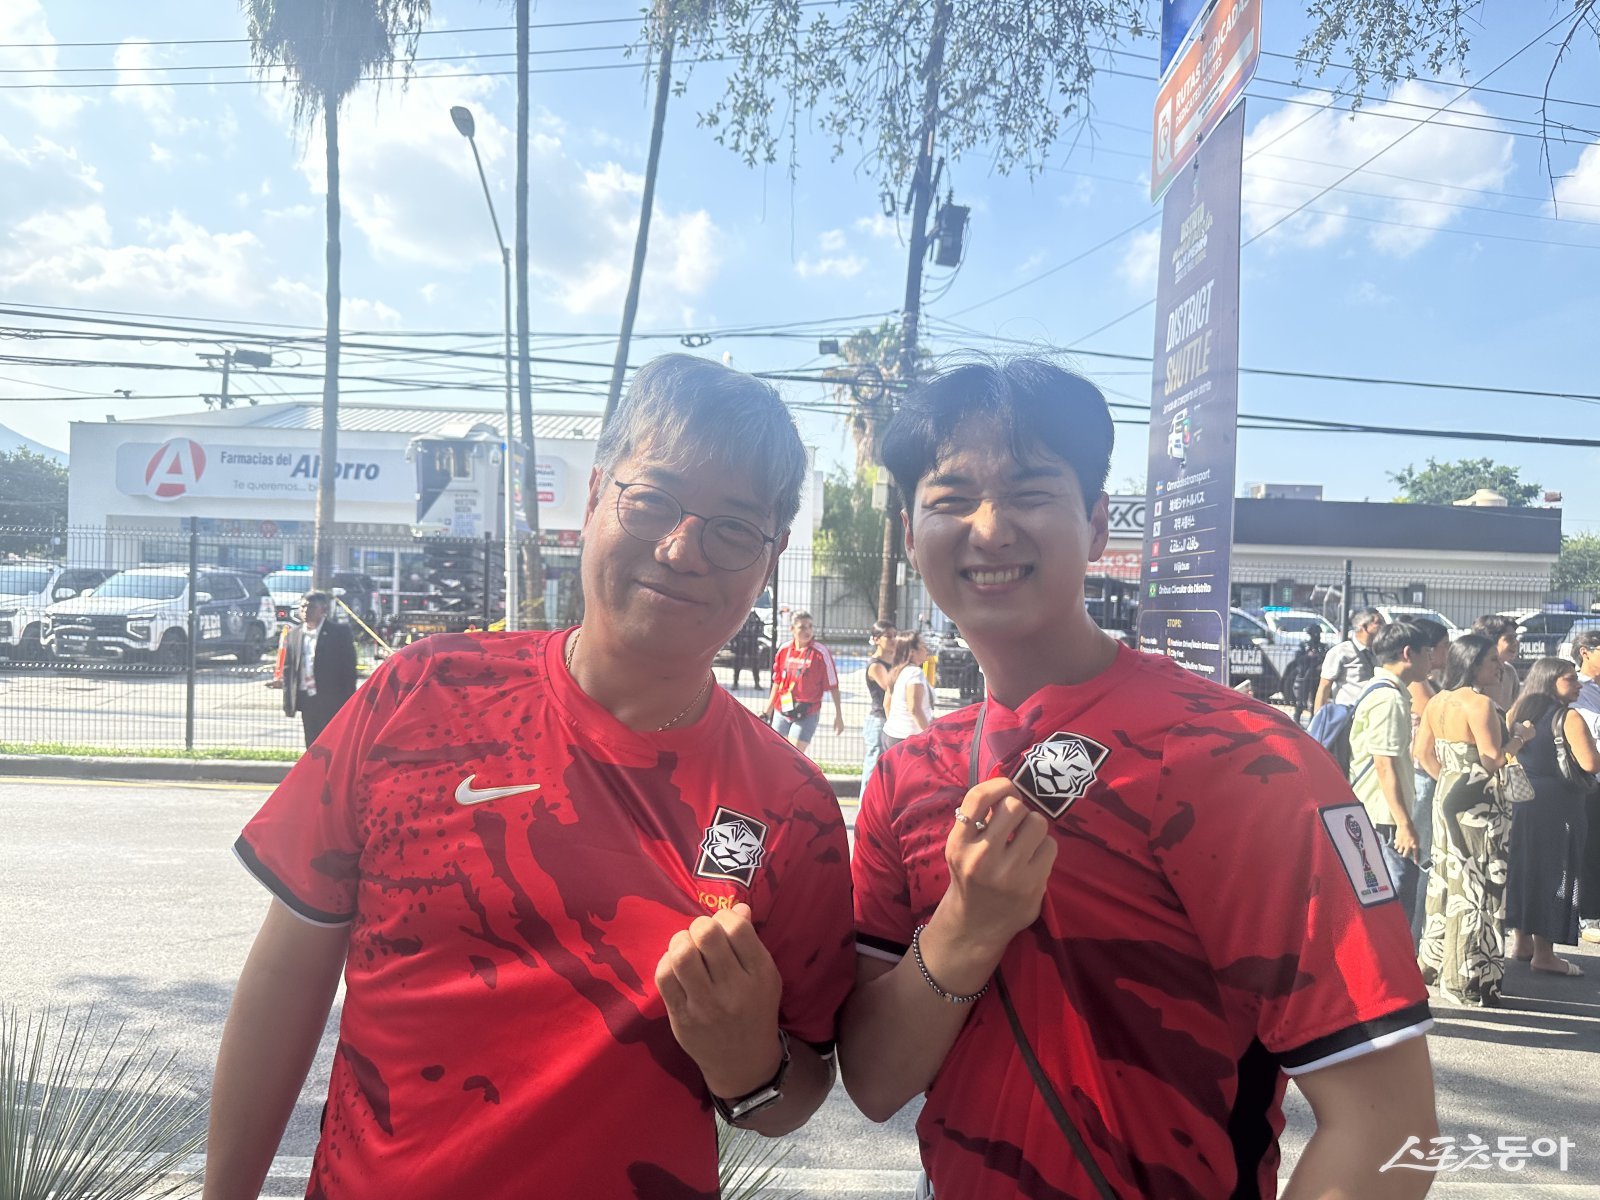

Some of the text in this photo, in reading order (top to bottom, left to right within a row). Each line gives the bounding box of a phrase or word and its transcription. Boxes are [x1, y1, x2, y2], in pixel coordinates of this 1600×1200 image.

[1176, 62, 1201, 112] RUTAS
[1176, 85, 1202, 128] DEDICATED
[1203, 52, 1223, 89] ROUTES
[1166, 279, 1215, 352] DISTRICT
[1164, 329, 1212, 396] SHUTTLE
[221, 451, 274, 465] Farmacias
[276, 453, 292, 466] del
[233, 480, 244, 490] Te
